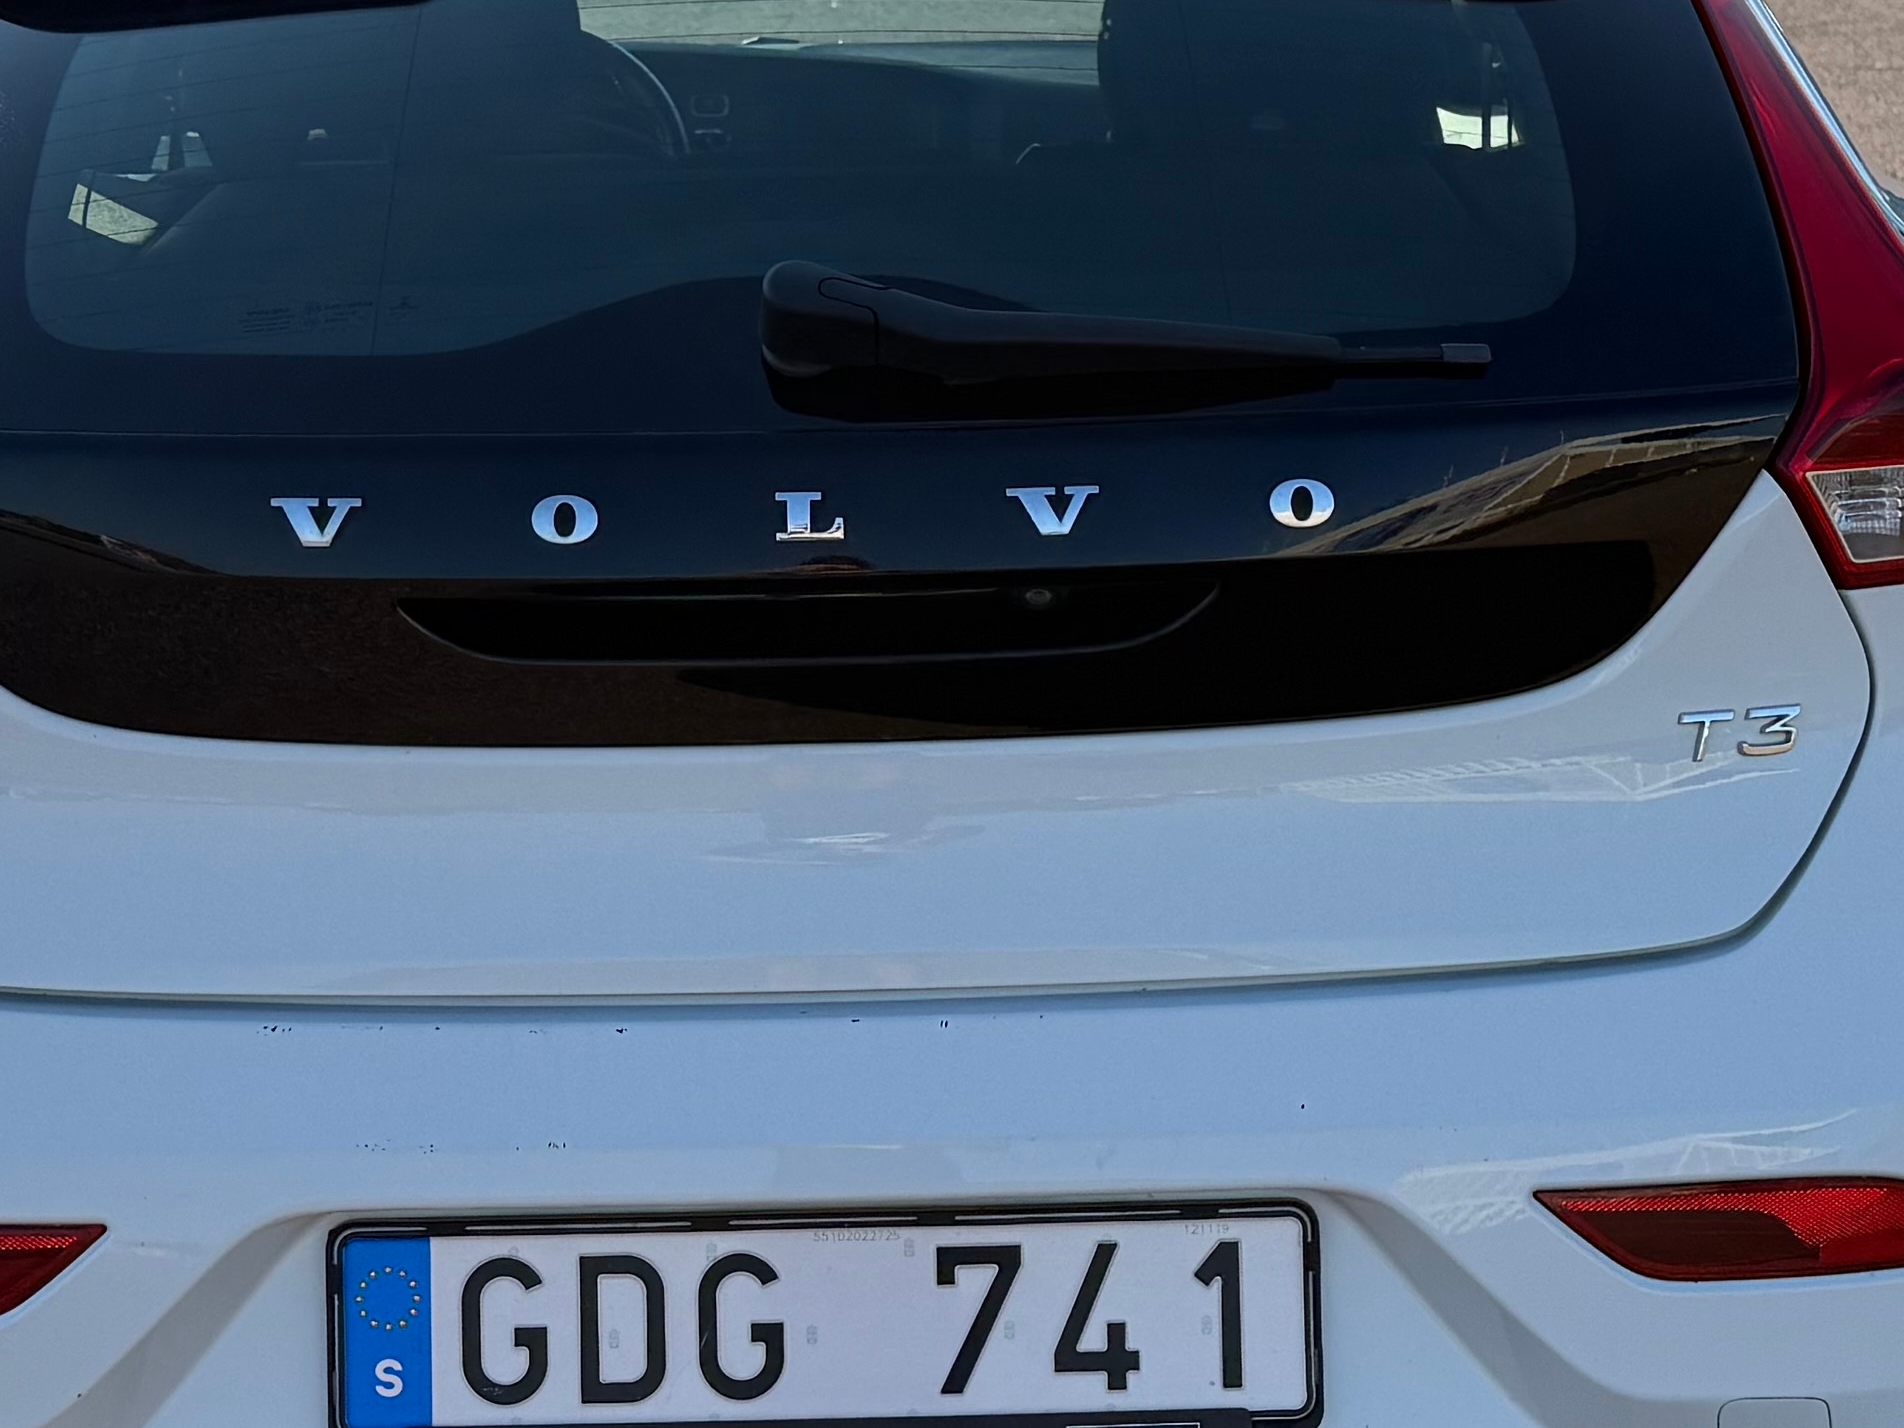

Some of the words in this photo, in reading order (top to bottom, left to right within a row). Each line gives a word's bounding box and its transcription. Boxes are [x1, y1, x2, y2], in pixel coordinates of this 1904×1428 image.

[270, 478, 1335, 548] VOLVO
[1678, 703, 1801, 762] T3
[460, 1252, 785, 1406] GDG
[936, 1240, 1243, 1395] 741
[375, 1358, 403, 1397] S
